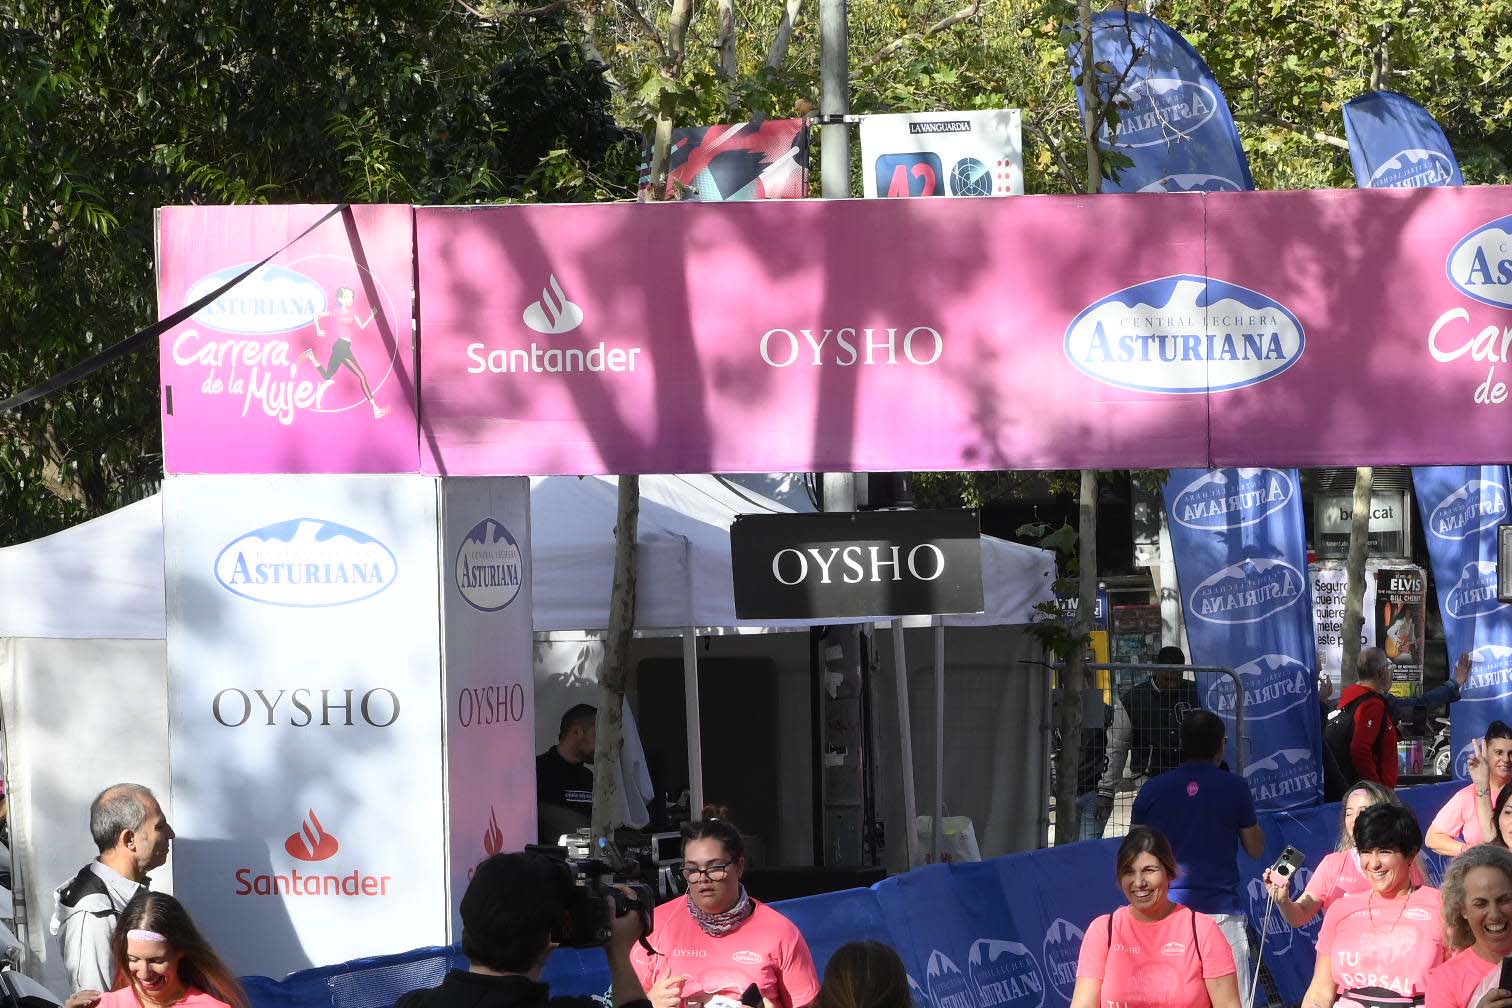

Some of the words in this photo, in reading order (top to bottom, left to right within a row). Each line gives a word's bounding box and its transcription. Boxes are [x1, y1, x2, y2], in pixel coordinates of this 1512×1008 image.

[204, 294, 316, 316] STURIANA
[172, 329, 292, 367] Carrera
[467, 342, 641, 376] Santander
[760, 327, 943, 368] OYSHO
[1086, 320, 1287, 363] ASTURIANA
[201, 368, 224, 394] de
[228, 367, 245, 394] la
[242, 363, 335, 425] Mujer
[1474, 365, 1509, 405] de
[229, 551, 385, 585] ASTURIANA
[461, 553, 519, 589] ASTURIANA
[772, 543, 945, 586] OYSHO
[1390, 578, 1422, 591] ELVIS
[212, 688, 401, 728] OYSHO
[458, 683, 525, 728] OYSHO
[235, 867, 391, 897] Santander
[1337, 951, 1360, 967] TU
[1342, 972, 1412, 994] DORSAL
